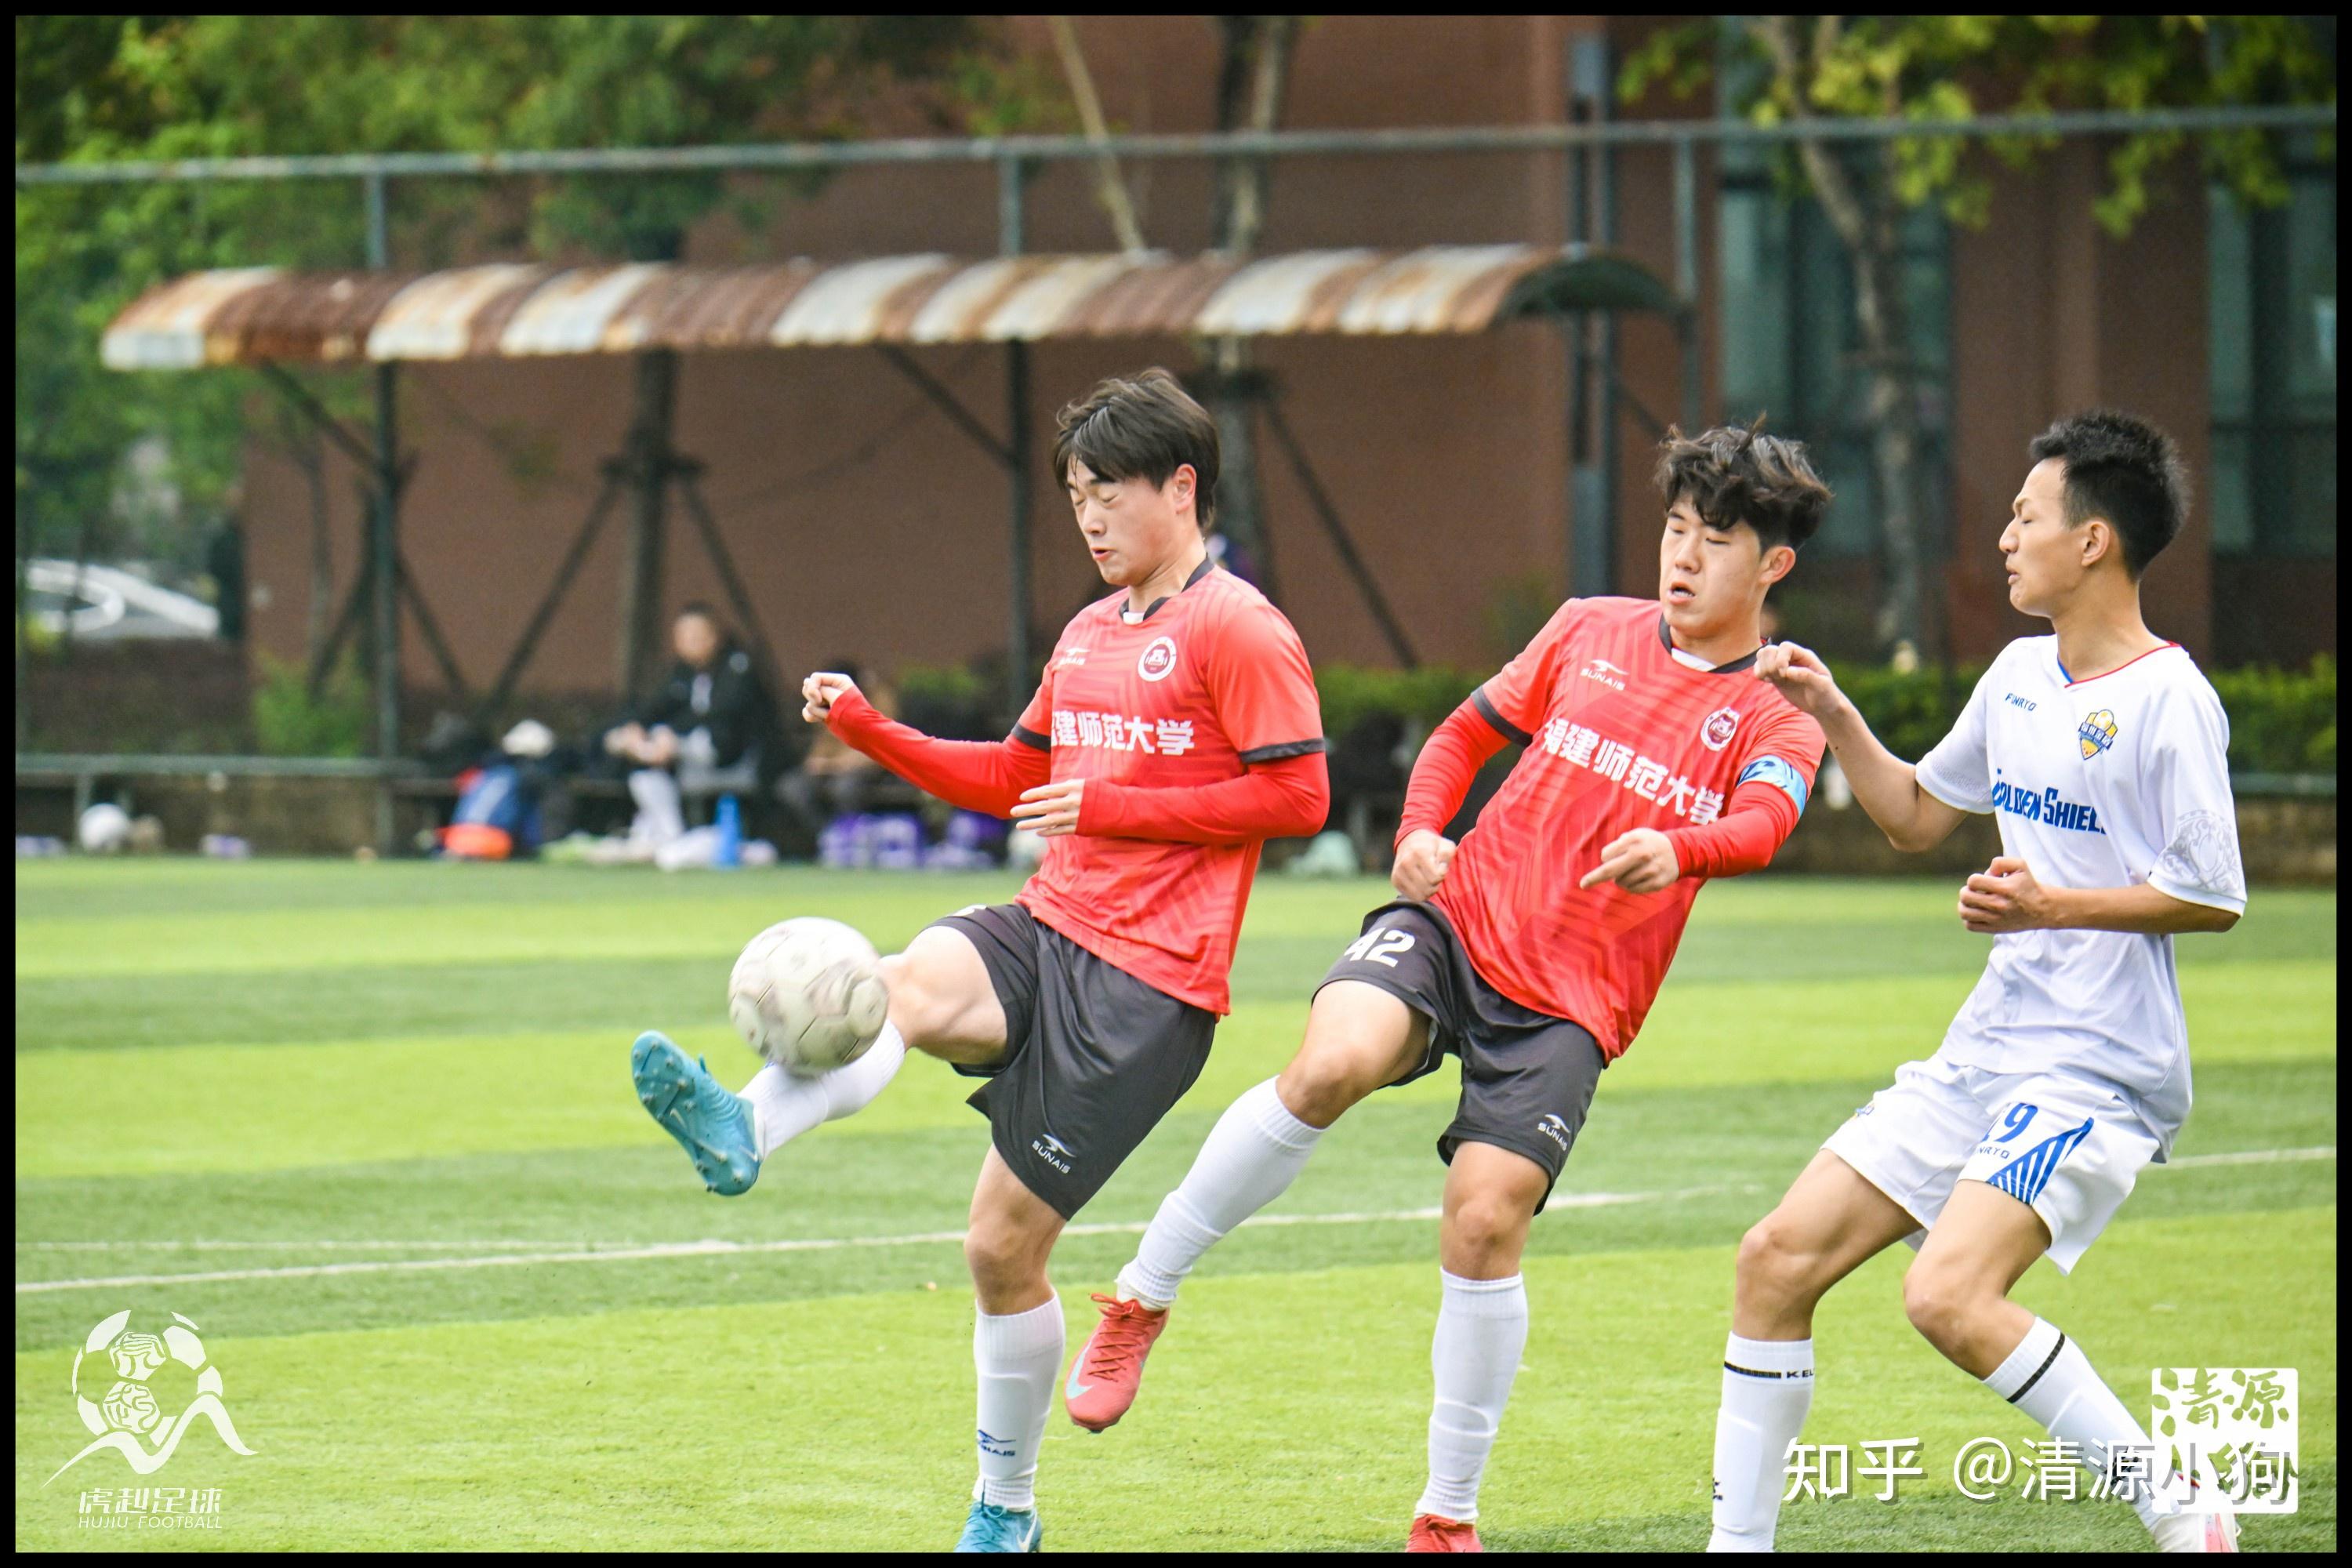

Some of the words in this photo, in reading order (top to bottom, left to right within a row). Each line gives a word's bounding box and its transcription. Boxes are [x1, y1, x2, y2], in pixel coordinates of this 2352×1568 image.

[1580, 668, 1626, 691] SUNAIS
[1051, 710, 1196, 757] 建师范大学
[1541, 717, 1726, 826] 福建师范大学
[2043, 786, 2107, 835] SHIEL
[1344, 927, 1416, 968] 42
[1537, 1122, 1568, 1152] SUNAIS
[1981, 1102, 2038, 1143] 9
[1032, 1140, 1071, 1174] SUNAIS
[1787, 1367, 1815, 1378] KEL
